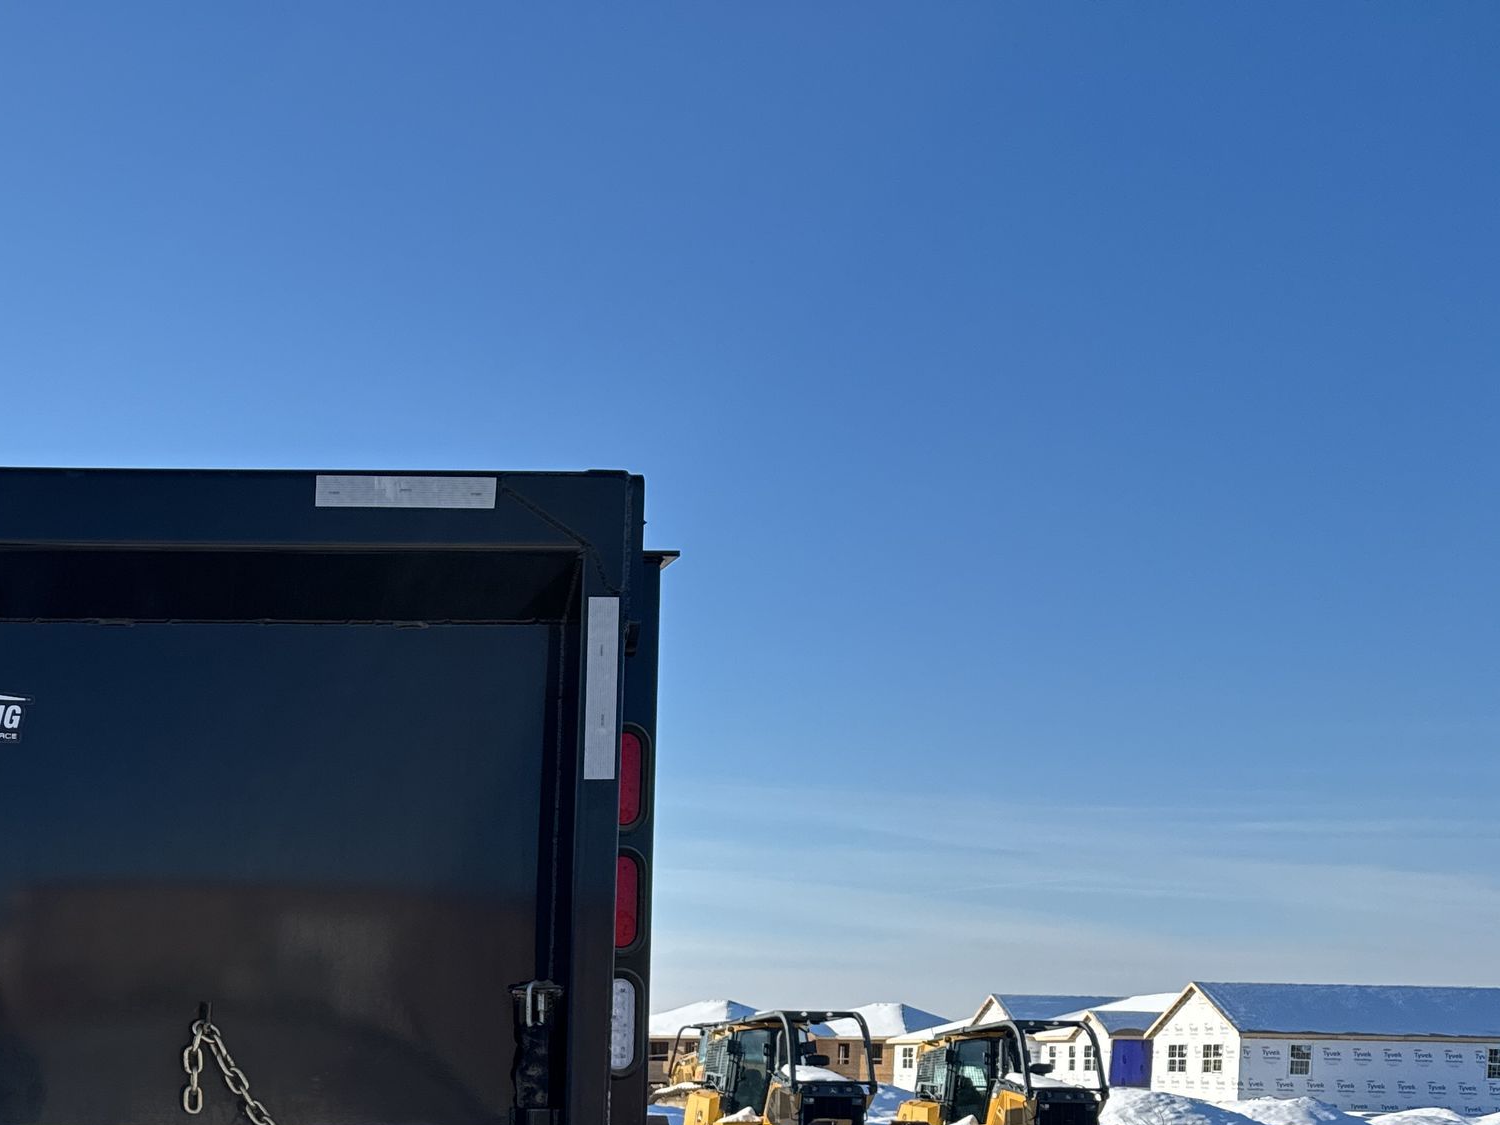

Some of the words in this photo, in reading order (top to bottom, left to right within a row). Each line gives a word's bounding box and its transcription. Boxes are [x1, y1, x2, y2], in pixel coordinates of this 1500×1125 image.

[1262, 1049, 1281, 1057] Tyvek
[1414, 1052, 1433, 1060] Tyvek
[1248, 1080, 1264, 1088] yvek
